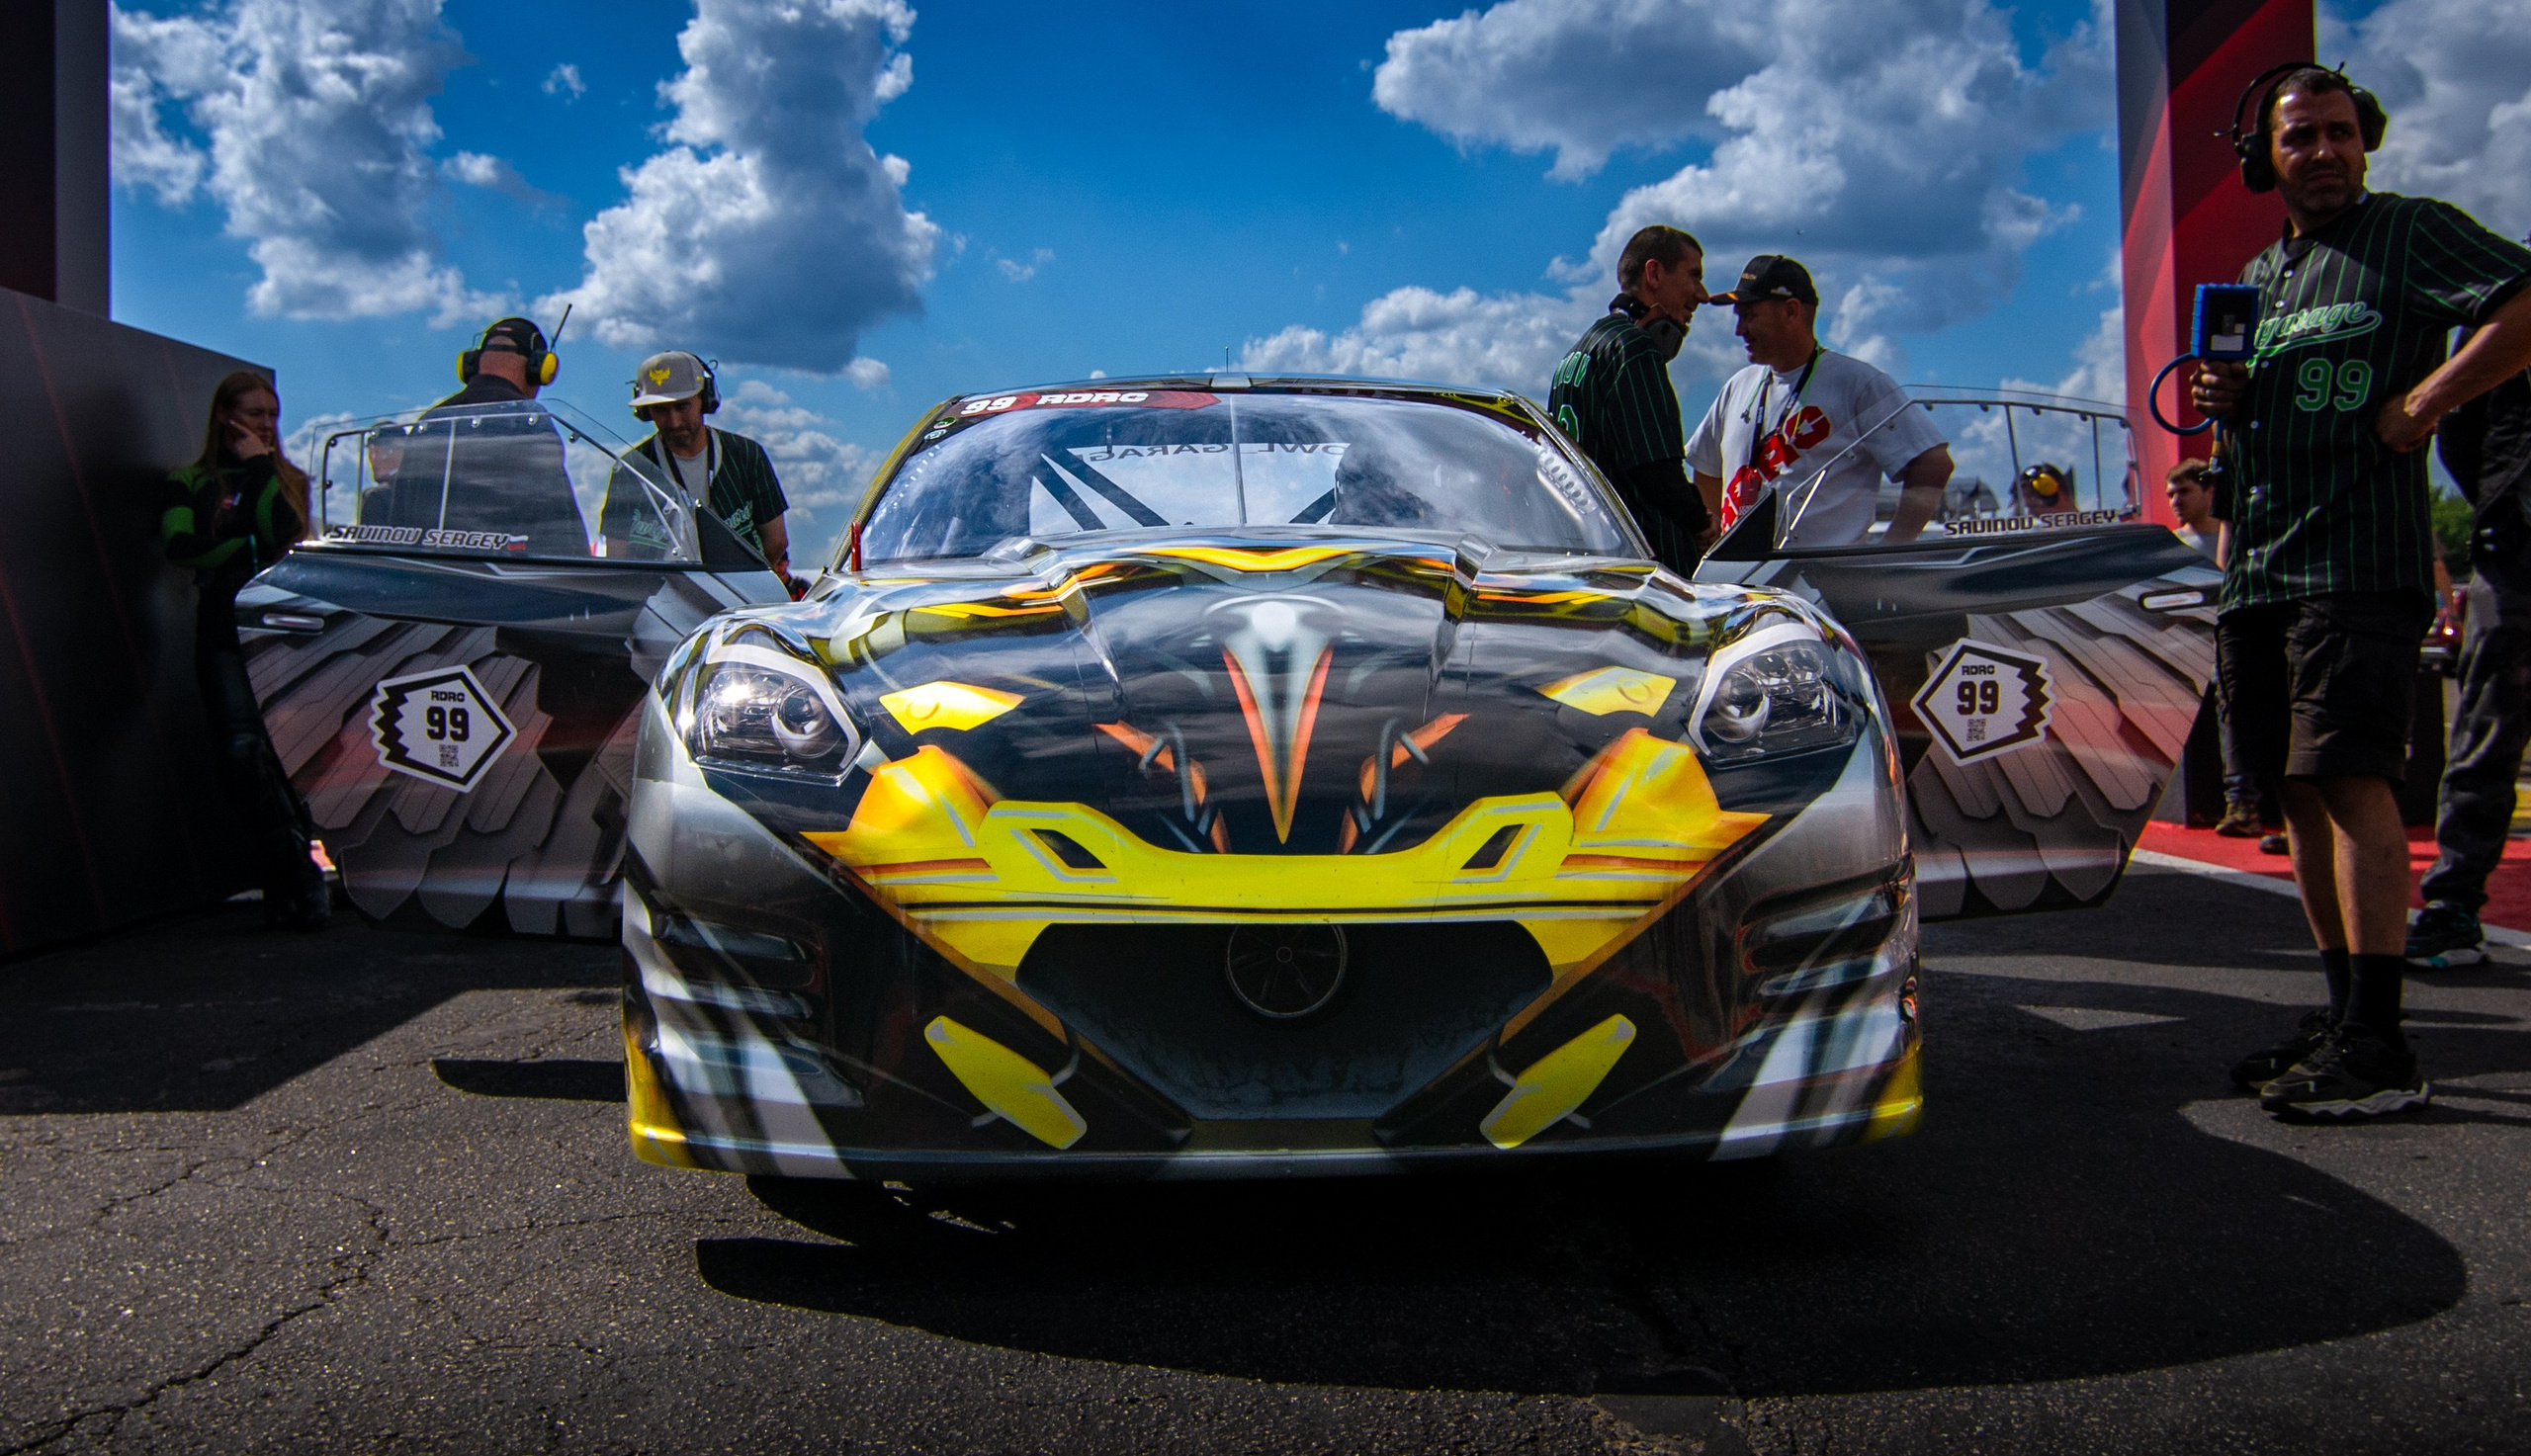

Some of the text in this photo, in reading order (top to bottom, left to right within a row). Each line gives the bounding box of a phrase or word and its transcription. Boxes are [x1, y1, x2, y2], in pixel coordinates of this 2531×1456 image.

[2296, 358, 2372, 411] 99
[960, 396, 1017, 414] 99
[2040, 509, 2117, 529] SERGEY
[422, 529, 510, 550] SERGEY
[1962, 665, 1996, 676] RDRC
[430, 690, 466, 703] RDRC
[1957, 680, 2001, 716] 99
[425, 706, 470, 742] 99
